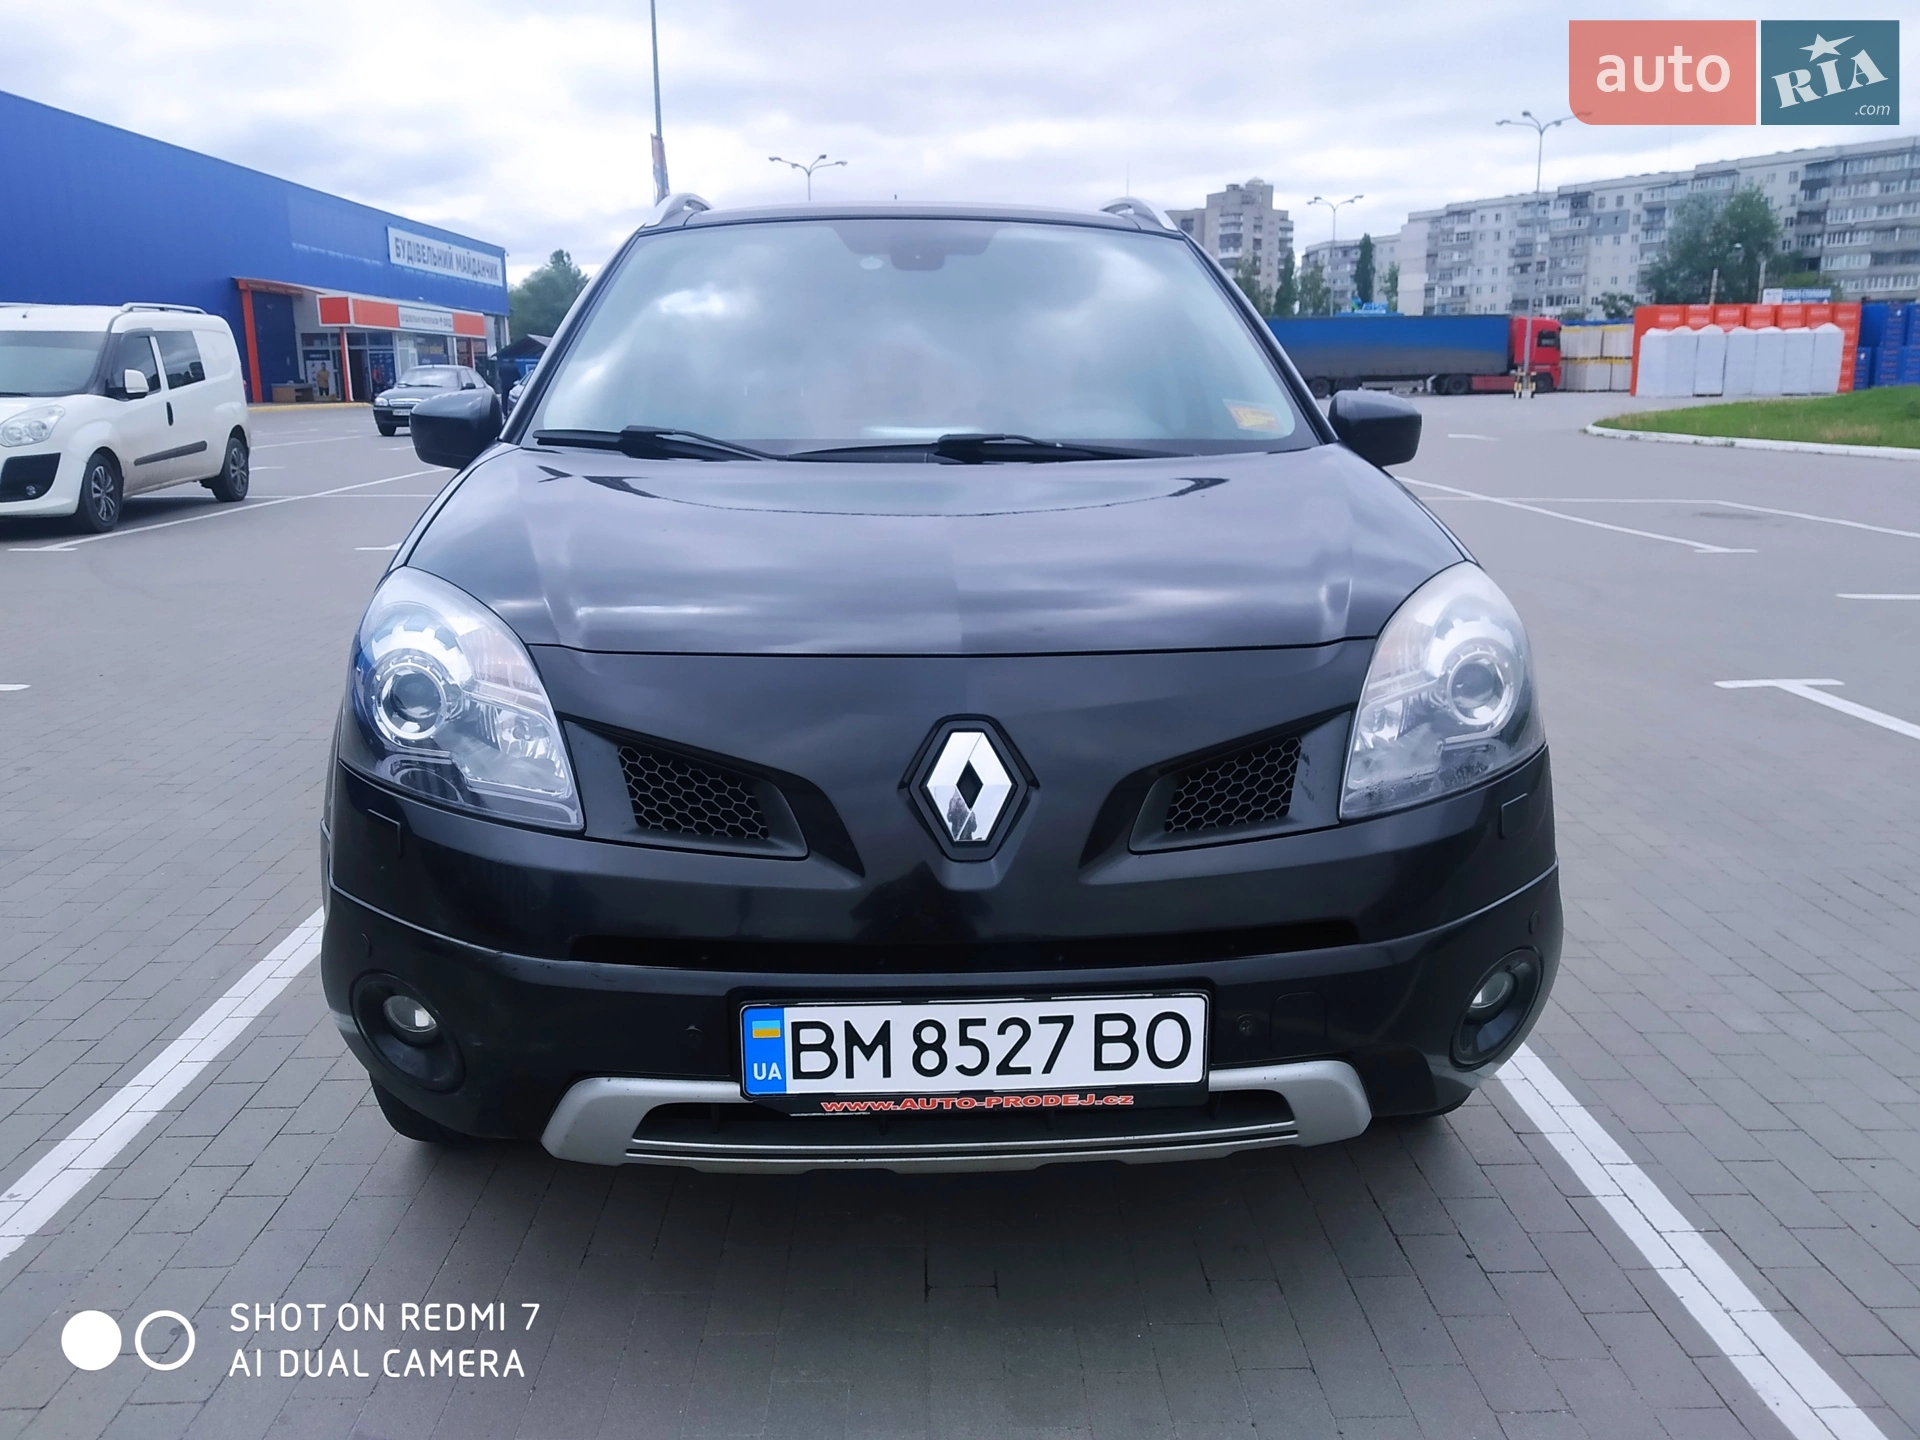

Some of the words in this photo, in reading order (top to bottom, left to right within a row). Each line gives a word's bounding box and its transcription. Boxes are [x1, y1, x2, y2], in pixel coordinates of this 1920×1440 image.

[394, 237, 454, 270] БУДІВЕЛЬНИЙ
[455, 251, 499, 280] МАЙДАНЧИК
[791, 1019, 892, 1080] BM
[911, 1015, 1075, 1078] 8527
[1093, 1010, 1192, 1073] BO
[752, 1062, 783, 1081] UA
[821, 1093, 1135, 1113] www.AUTO-PRODEJ.cz
